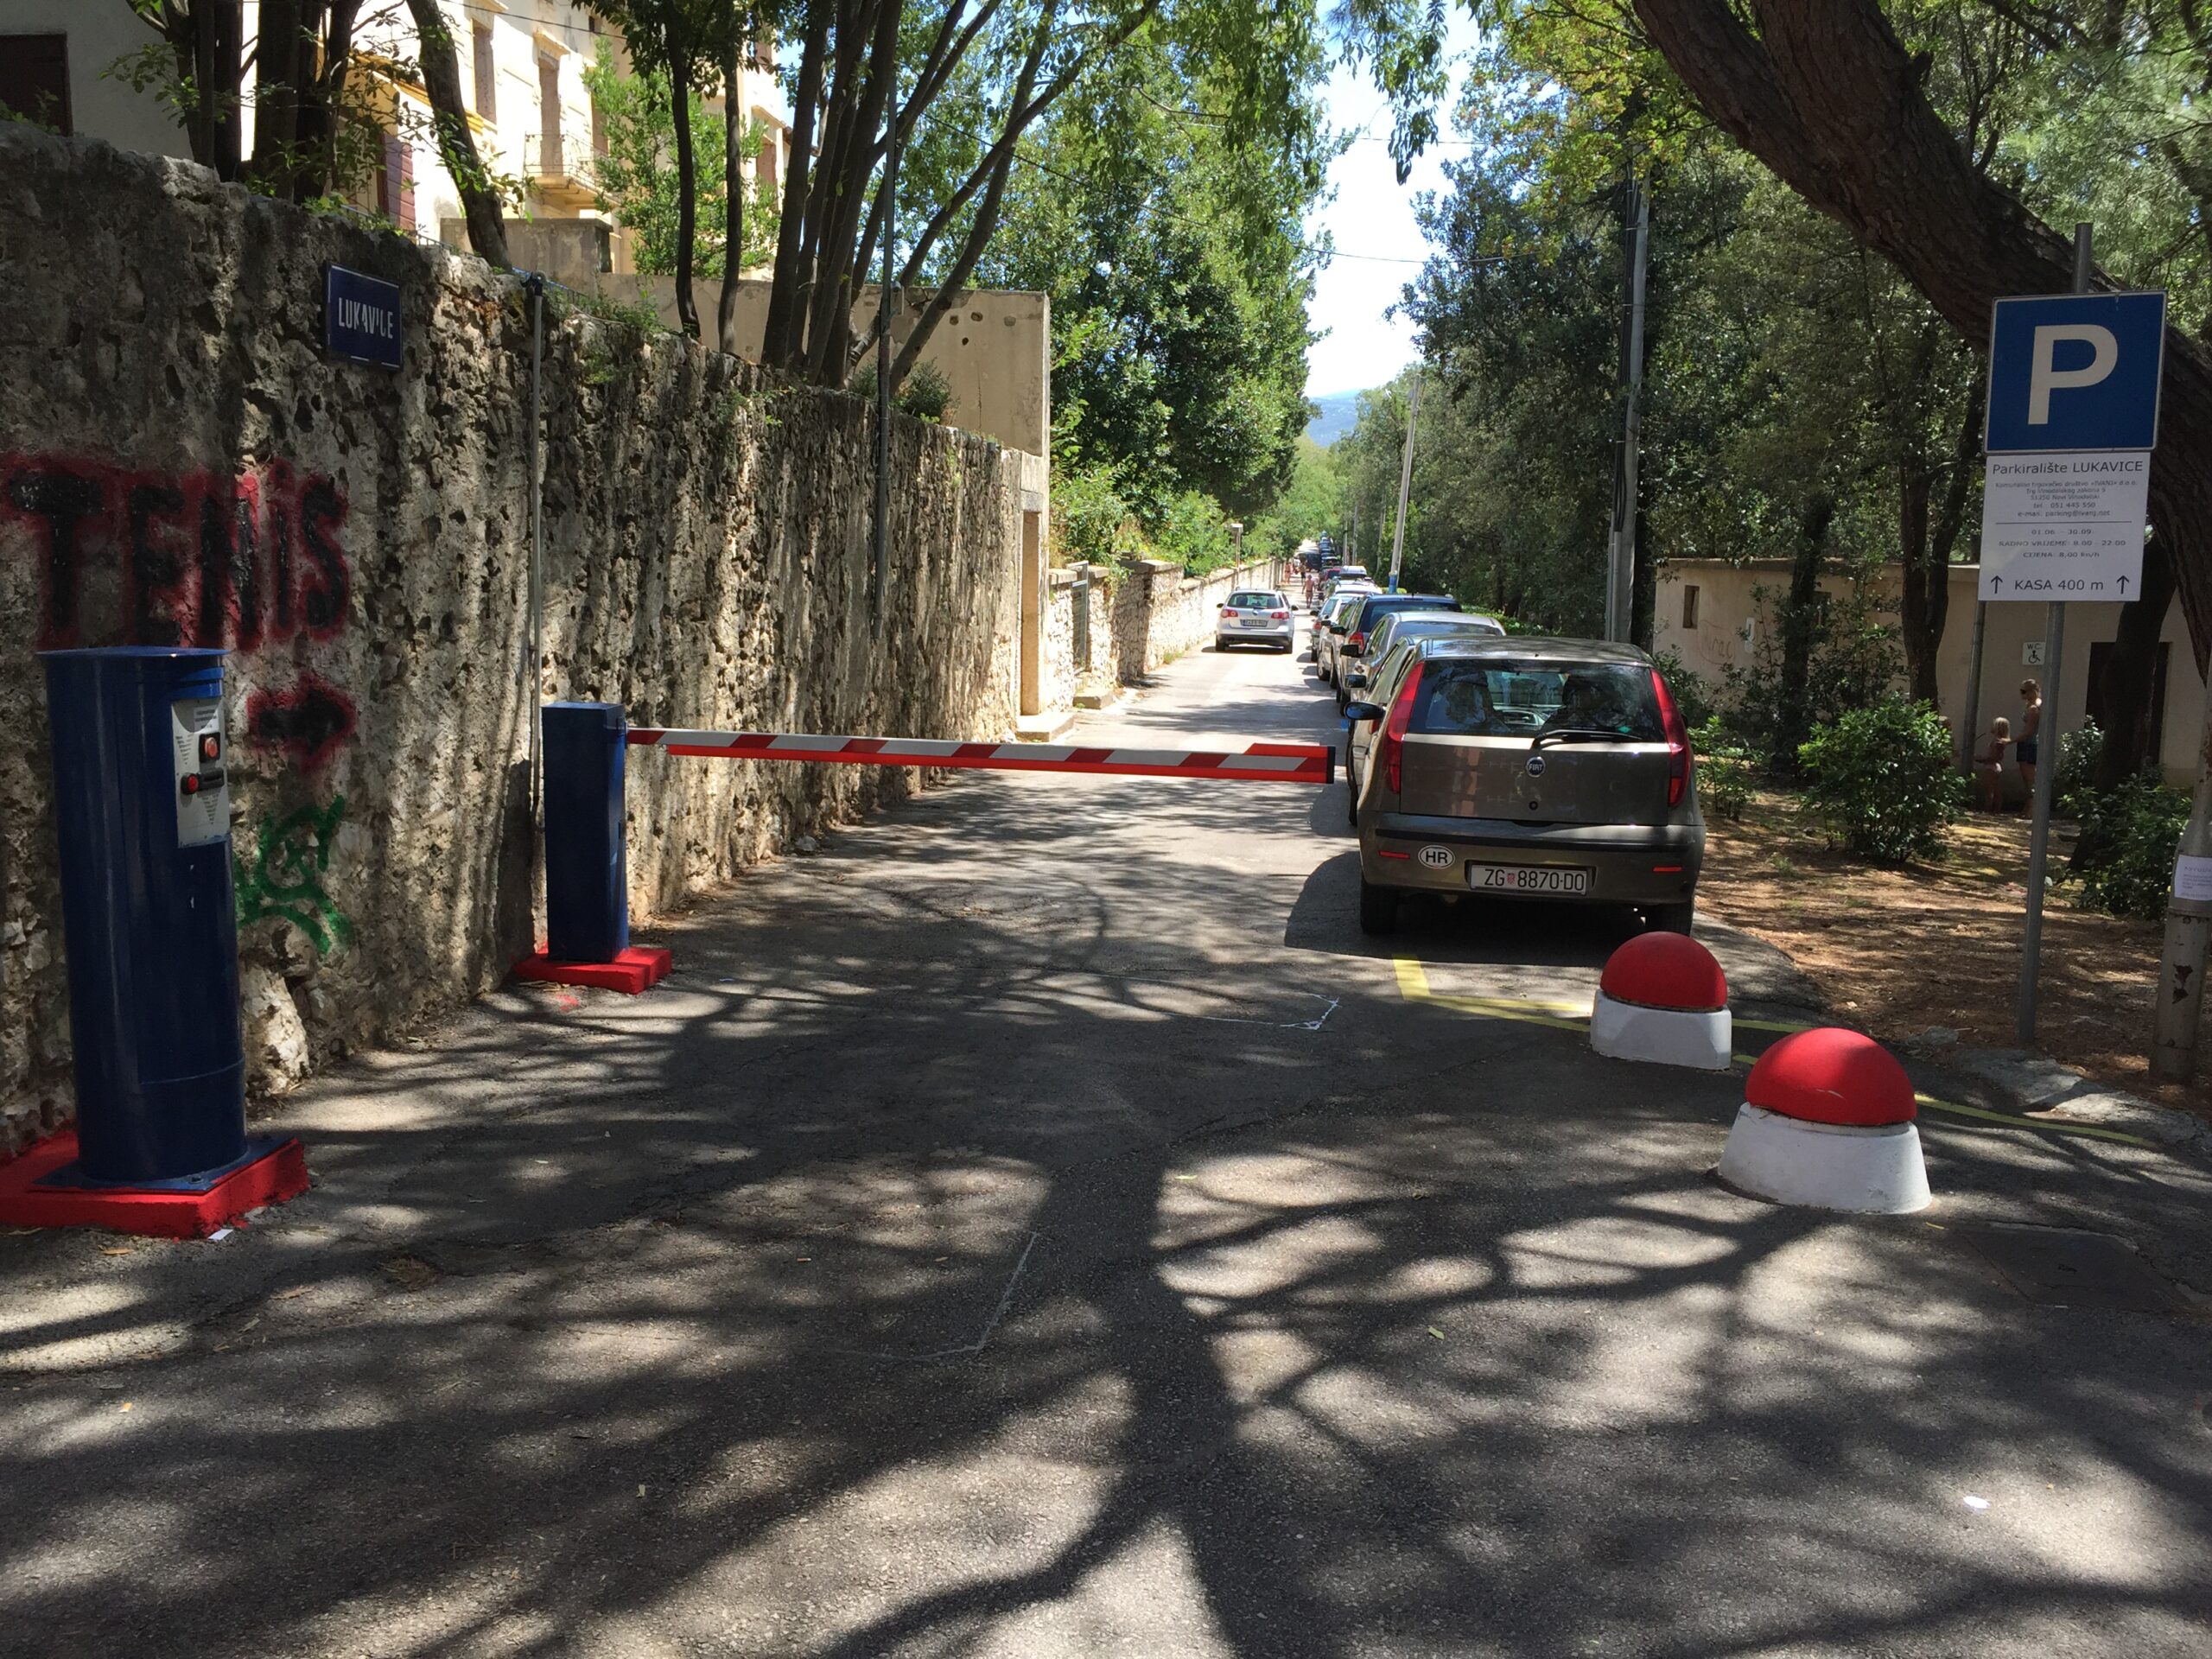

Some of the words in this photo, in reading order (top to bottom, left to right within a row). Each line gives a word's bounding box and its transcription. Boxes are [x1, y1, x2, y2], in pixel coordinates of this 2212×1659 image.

[2028, 324, 2118, 424] P
[1993, 461, 2068, 474] Parkiralište
[2074, 461, 2144, 473] LUKAVICE
[2015, 580, 2053, 590] KASA
[2057, 580, 2085, 590] 400
[2090, 582, 2104, 590] m
[1426, 851, 1448, 863] HR
[1484, 868, 1505, 887] ZG
